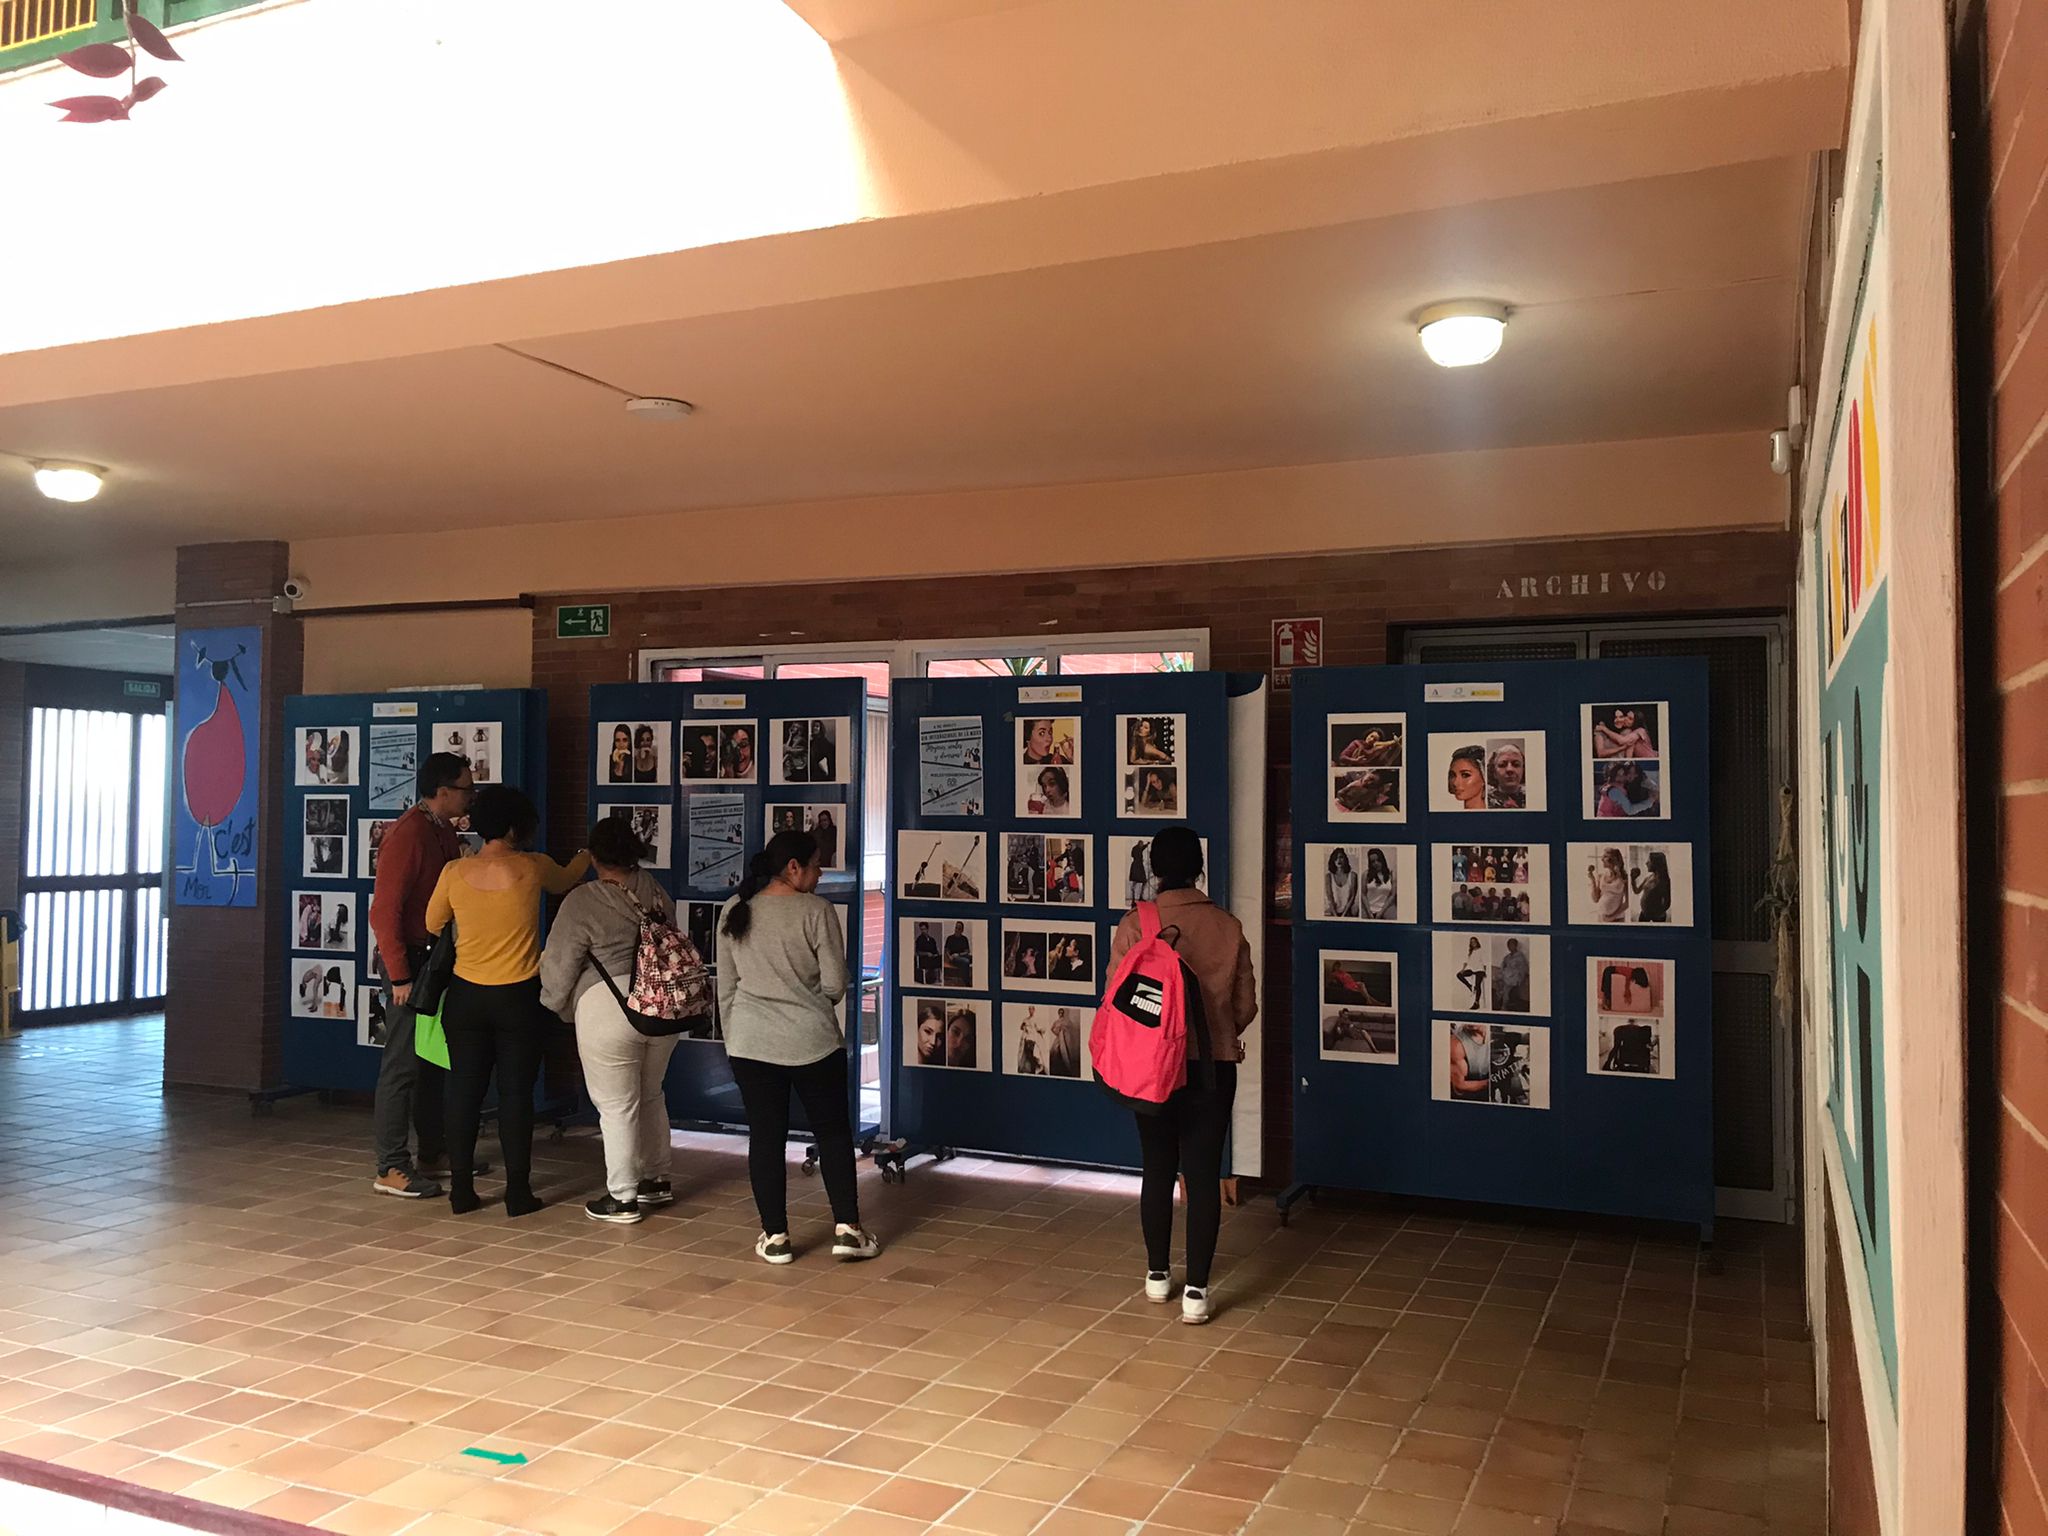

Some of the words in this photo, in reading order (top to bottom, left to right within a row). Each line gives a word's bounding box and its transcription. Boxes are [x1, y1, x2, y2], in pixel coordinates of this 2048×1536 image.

[1496, 570, 1666, 599] ARCHIVO
[214, 816, 257, 860] C'est
[1130, 994, 1162, 1016] PUMA
